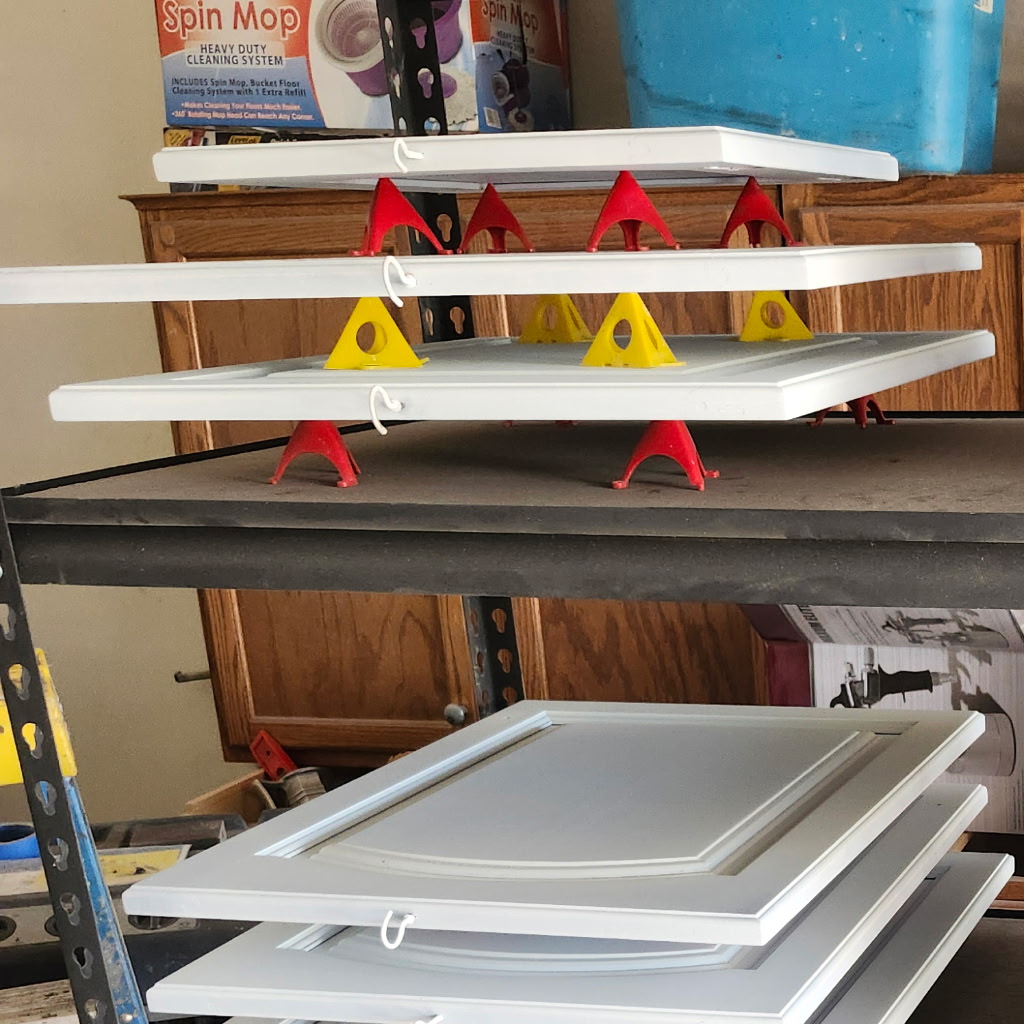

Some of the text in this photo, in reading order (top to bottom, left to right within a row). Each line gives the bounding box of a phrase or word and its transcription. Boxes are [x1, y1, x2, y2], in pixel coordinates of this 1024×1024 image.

[164, 0, 300, 40] Spin Mop
[482, 0, 539, 35] Spin Mop
[200, 43, 267, 54] HEAVY DUTY
[187, 55, 284, 66] CLEANING SYSTEM
[171, 78, 208, 86] INCLUDES
[210, 78, 228, 88] Spin
[250, 79, 278, 87] Bucket
[279, 79, 300, 88] Floor
[172, 87, 205, 97] Cleaning
[206, 87, 234, 97] System
[236, 88, 254, 96] with
[262, 88, 283, 96] Extra
[285, 88, 306, 97] Refill
